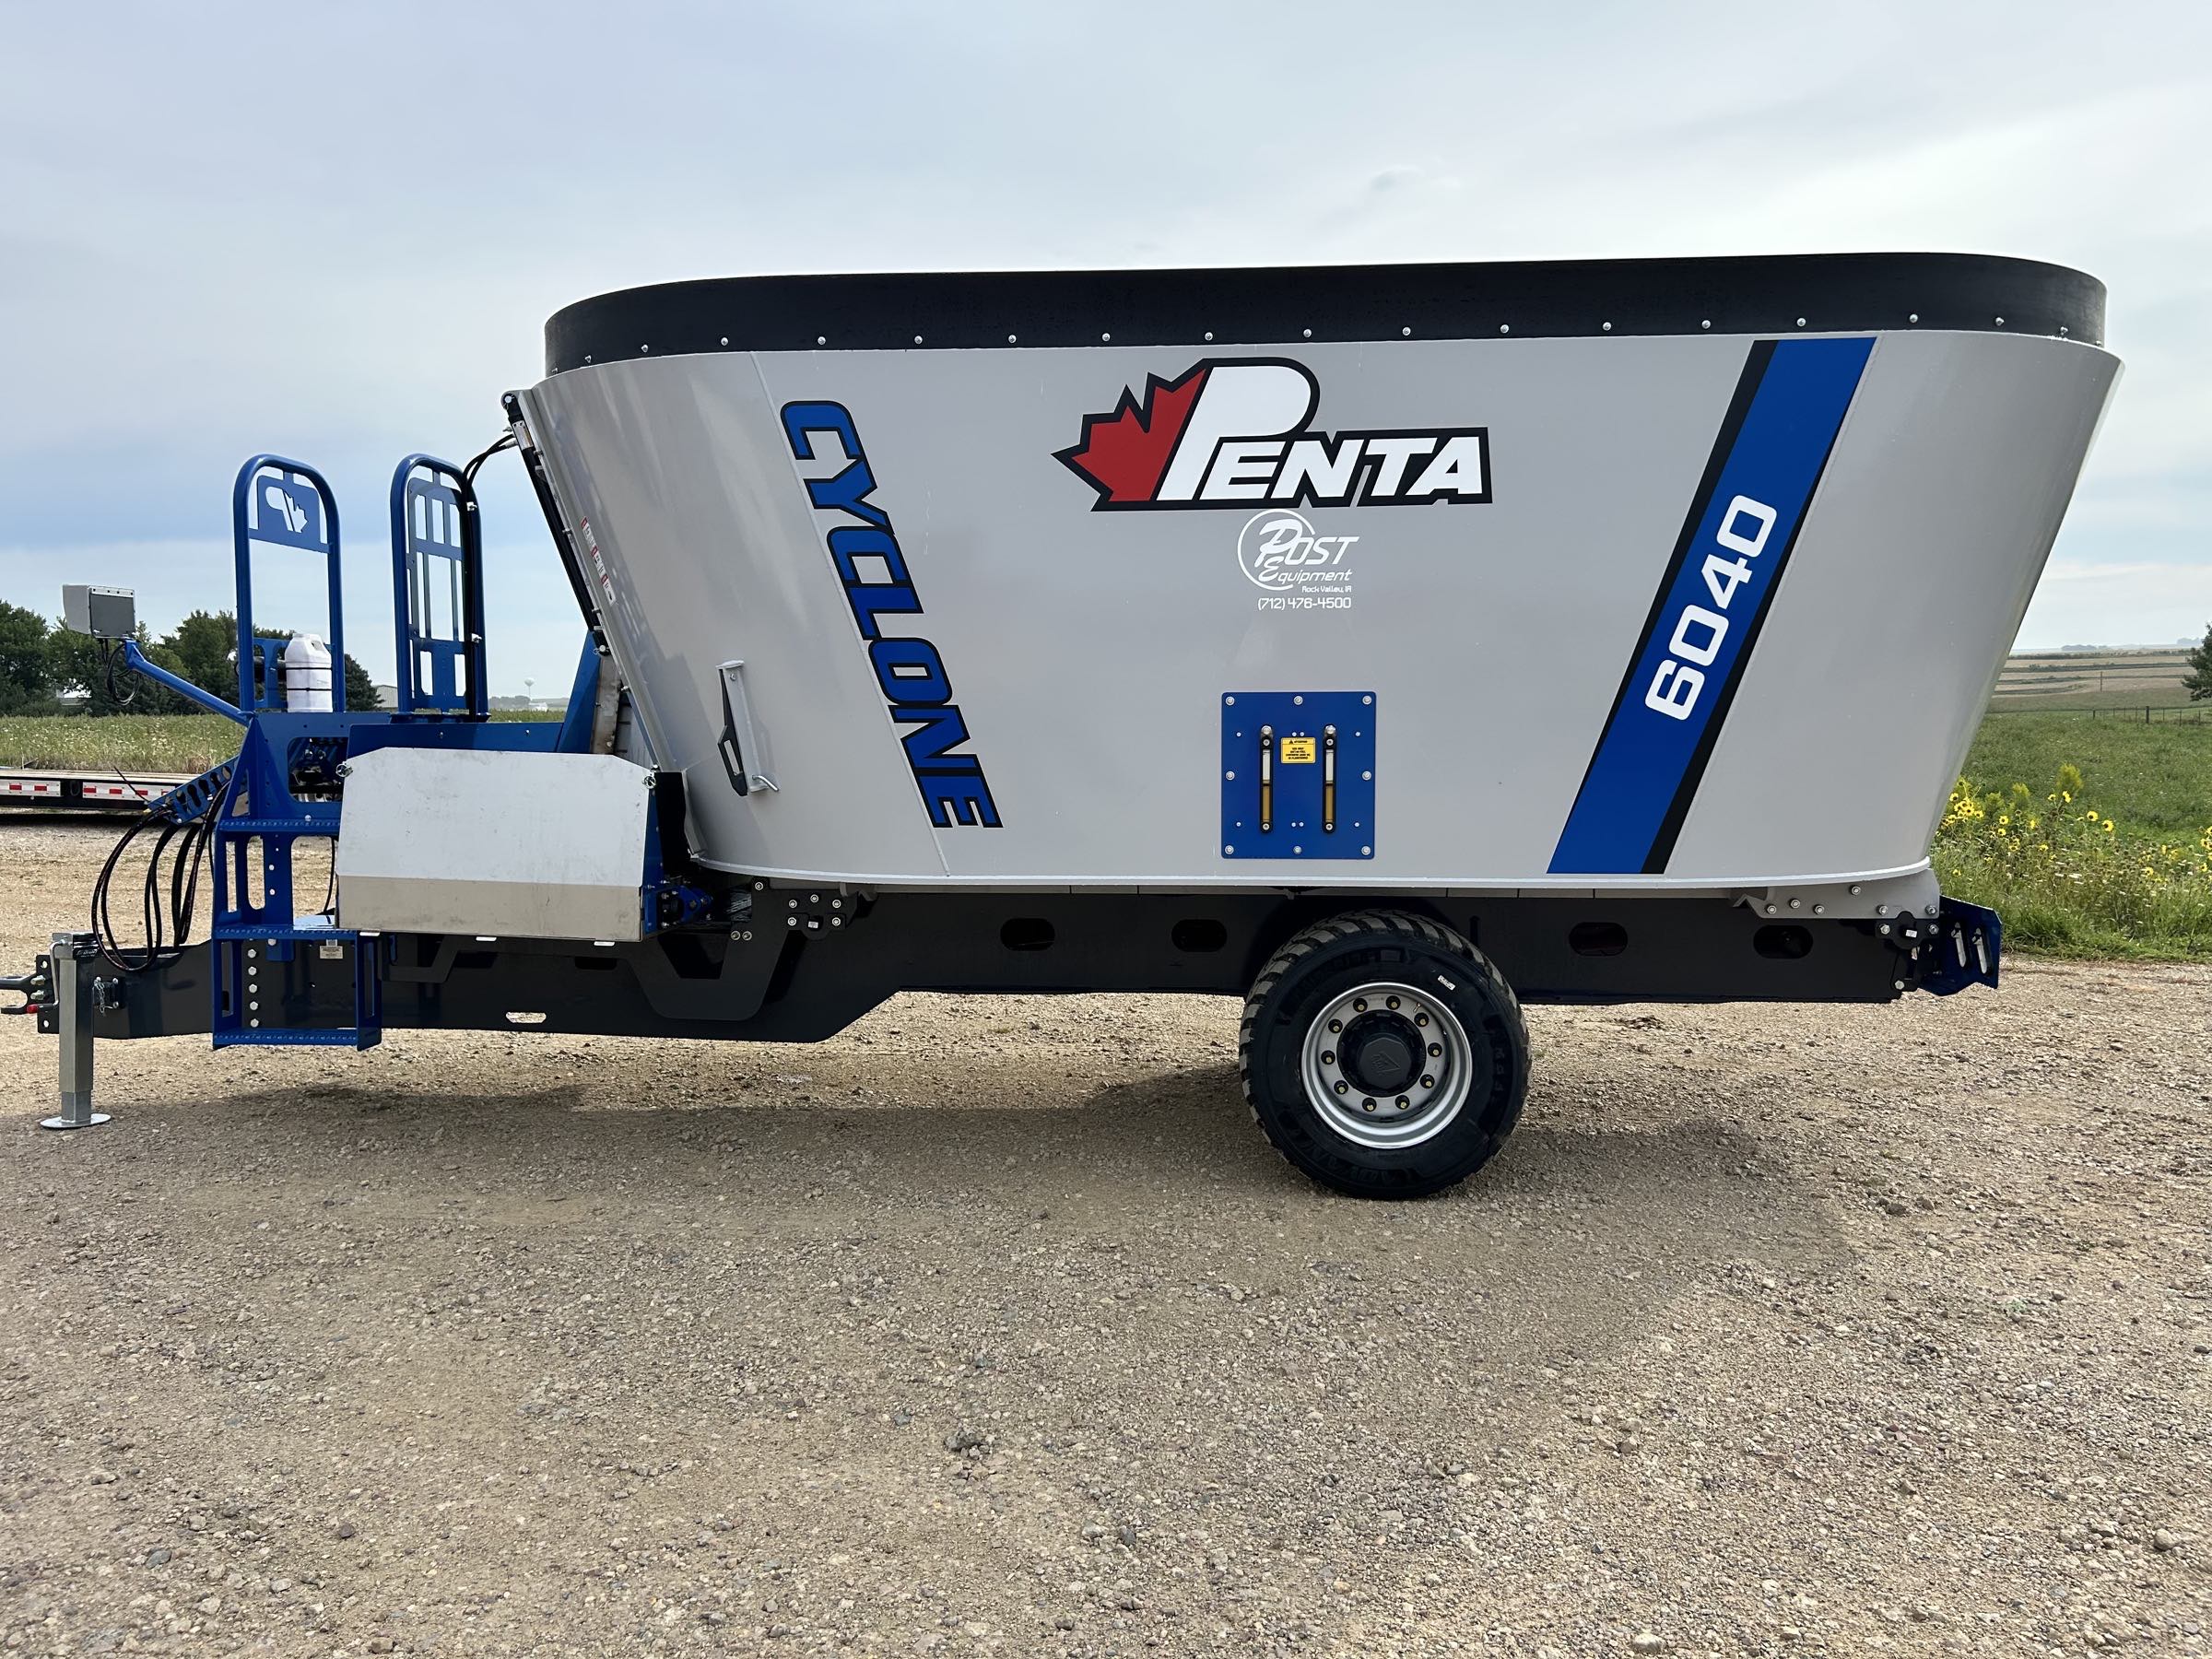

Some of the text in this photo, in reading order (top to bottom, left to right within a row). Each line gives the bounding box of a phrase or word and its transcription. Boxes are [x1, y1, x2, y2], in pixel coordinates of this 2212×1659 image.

[1154, 364, 1486, 503] PENTA
[781, 400, 1003, 828] CYCLONE
[1257, 597, 1352, 610] (712) 476-4500
[1258, 556, 1353, 584] Equipment
[1645, 495, 1778, 721] 6040
